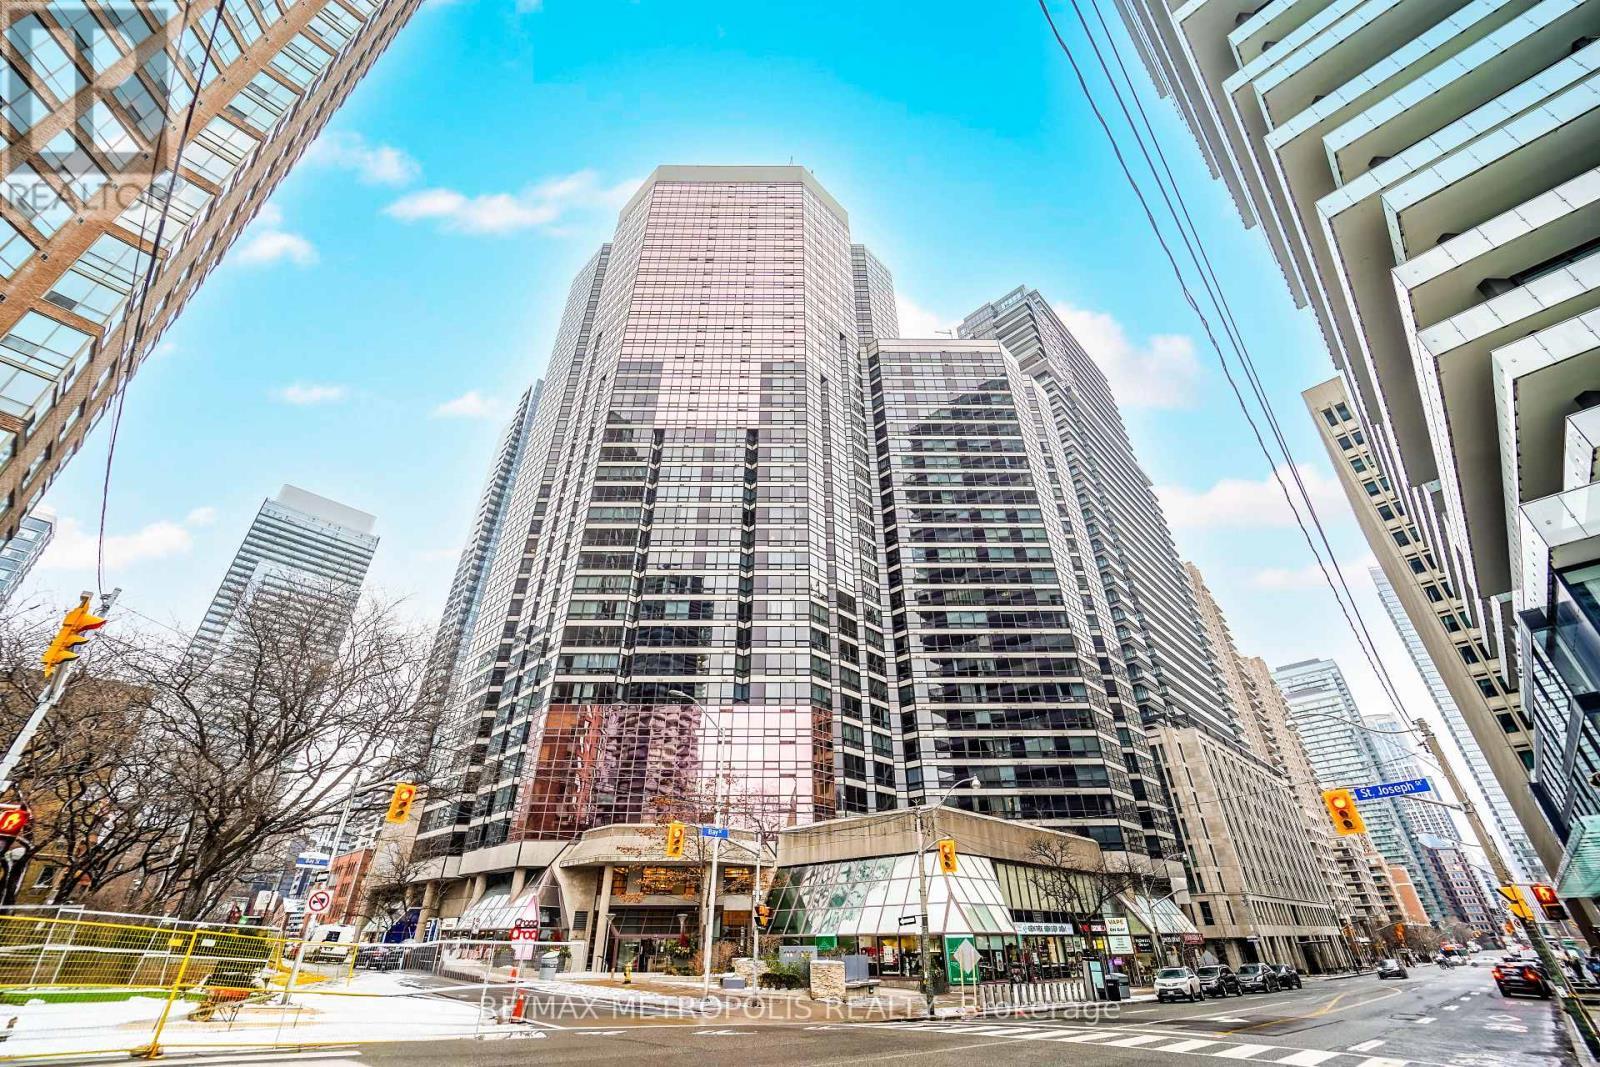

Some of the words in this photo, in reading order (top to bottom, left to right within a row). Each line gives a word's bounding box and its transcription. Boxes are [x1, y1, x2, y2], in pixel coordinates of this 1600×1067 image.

[1360, 788, 1375, 798] St.
[1378, 782, 1415, 796] Joseph
[709, 828, 719, 837] Bay
